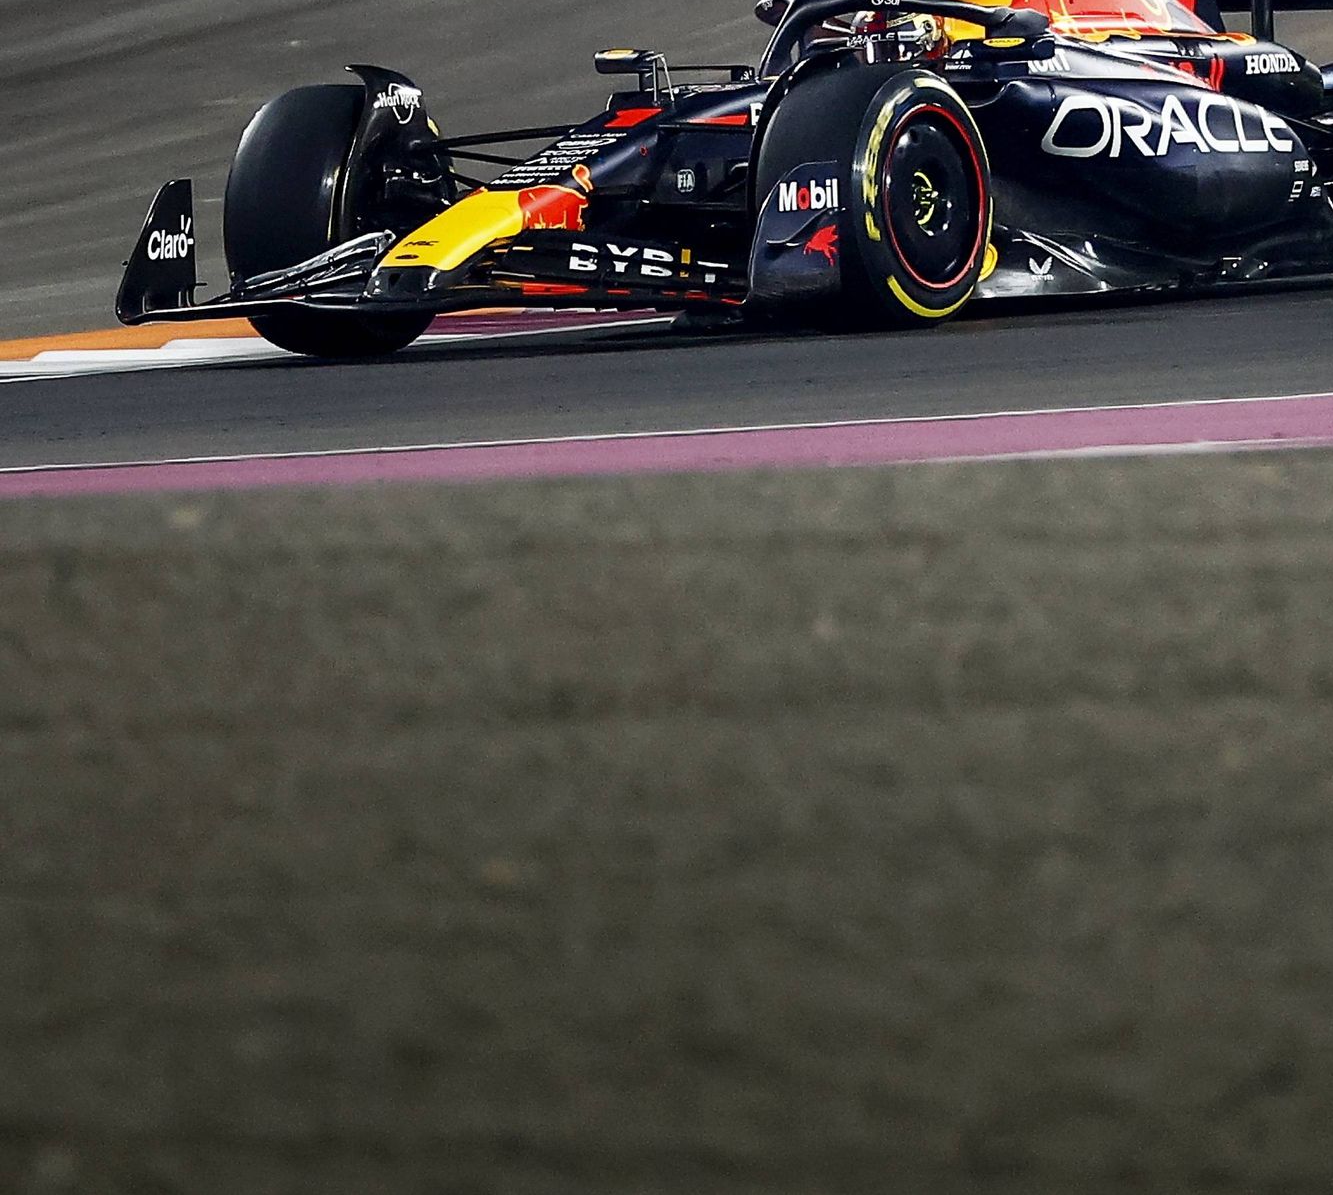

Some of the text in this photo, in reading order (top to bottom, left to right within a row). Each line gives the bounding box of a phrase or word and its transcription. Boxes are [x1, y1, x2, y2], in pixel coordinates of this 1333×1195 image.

[1245, 53, 1301, 75] HONDA
[1041, 94, 1293, 158] ORACLE
[778, 178, 839, 212] Mobil
[148, 228, 189, 261] Claro
